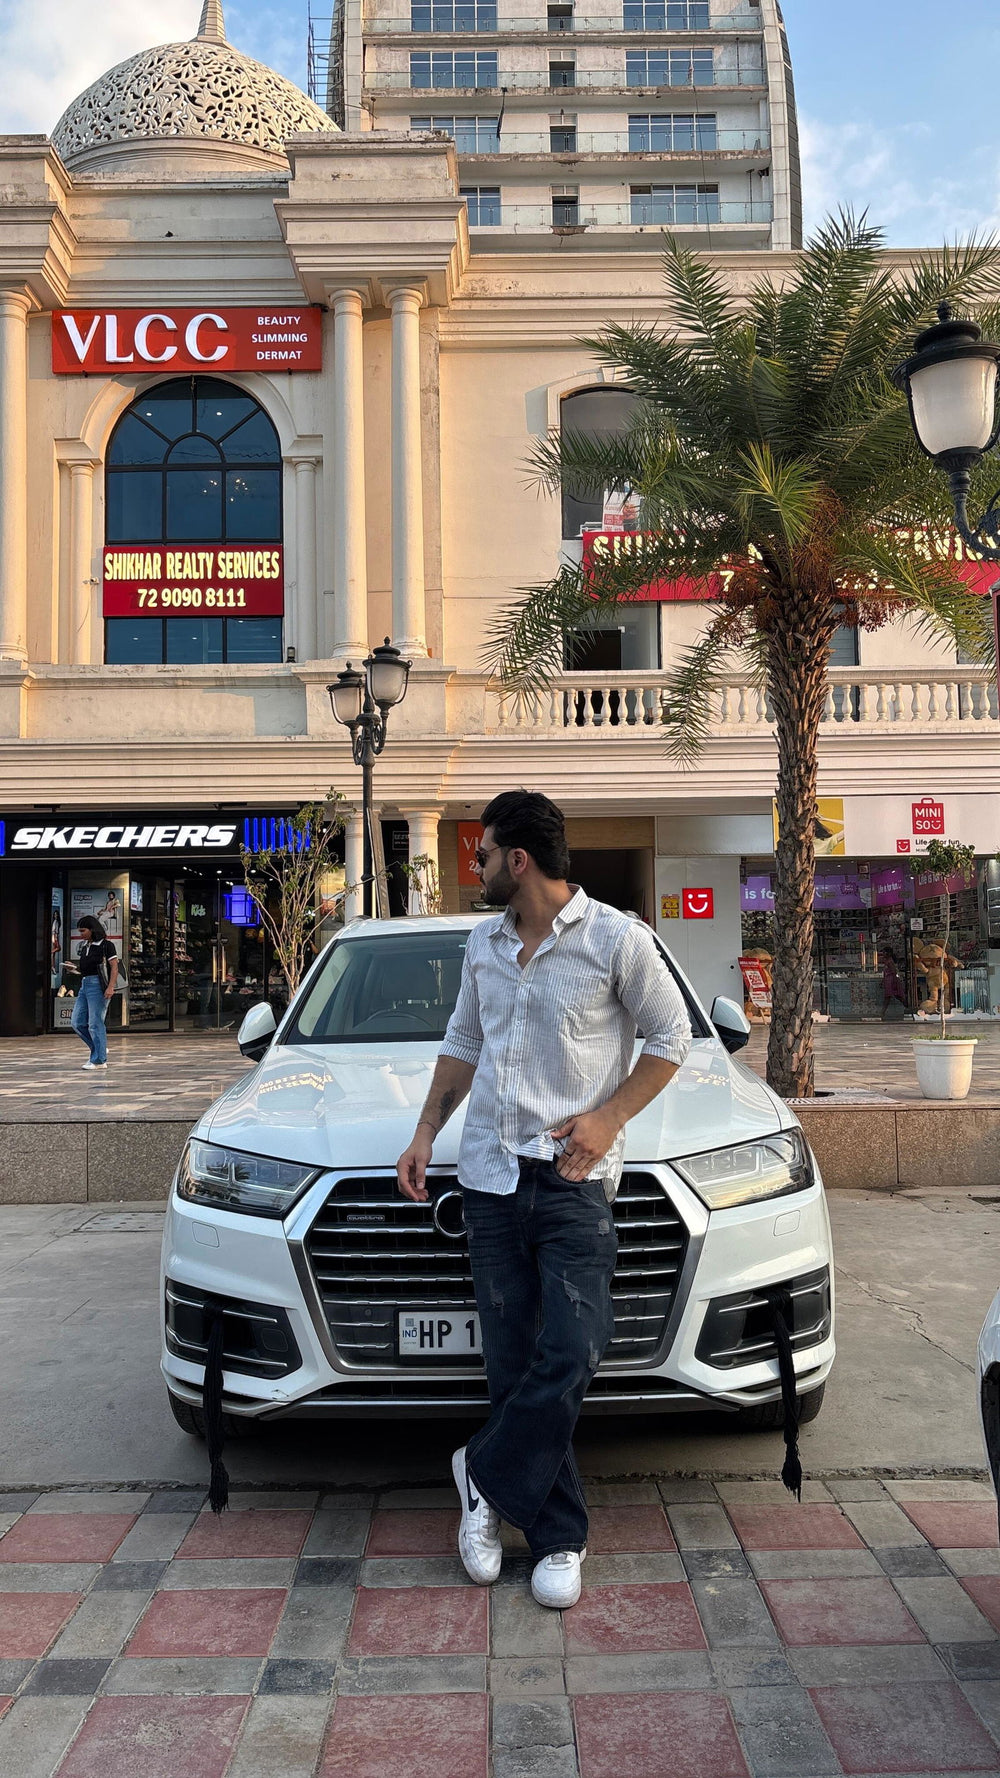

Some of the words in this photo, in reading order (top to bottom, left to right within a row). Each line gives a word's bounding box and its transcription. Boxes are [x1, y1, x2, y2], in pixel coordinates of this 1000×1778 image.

[257, 316, 301, 325] BEAUTY
[62, 313, 229, 363] VLCC
[251, 333, 308, 343] SLIMMING
[256, 350, 302, 360] DERMAT
[104, 552, 162, 580] SHIKHAR
[166, 552, 214, 579] REALTY
[217, 551, 280, 579] SERVICES
[137, 588, 158, 607] 72
[161, 588, 202, 607] 9090
[205, 588, 247, 607] 8111
[914, 808, 941, 818] MINI
[11, 825, 236, 849] SKECHERS
[745, 888, 756, 899] is
[402, 1329, 417, 1338] IND
[419, 1320, 453, 1348] HP
